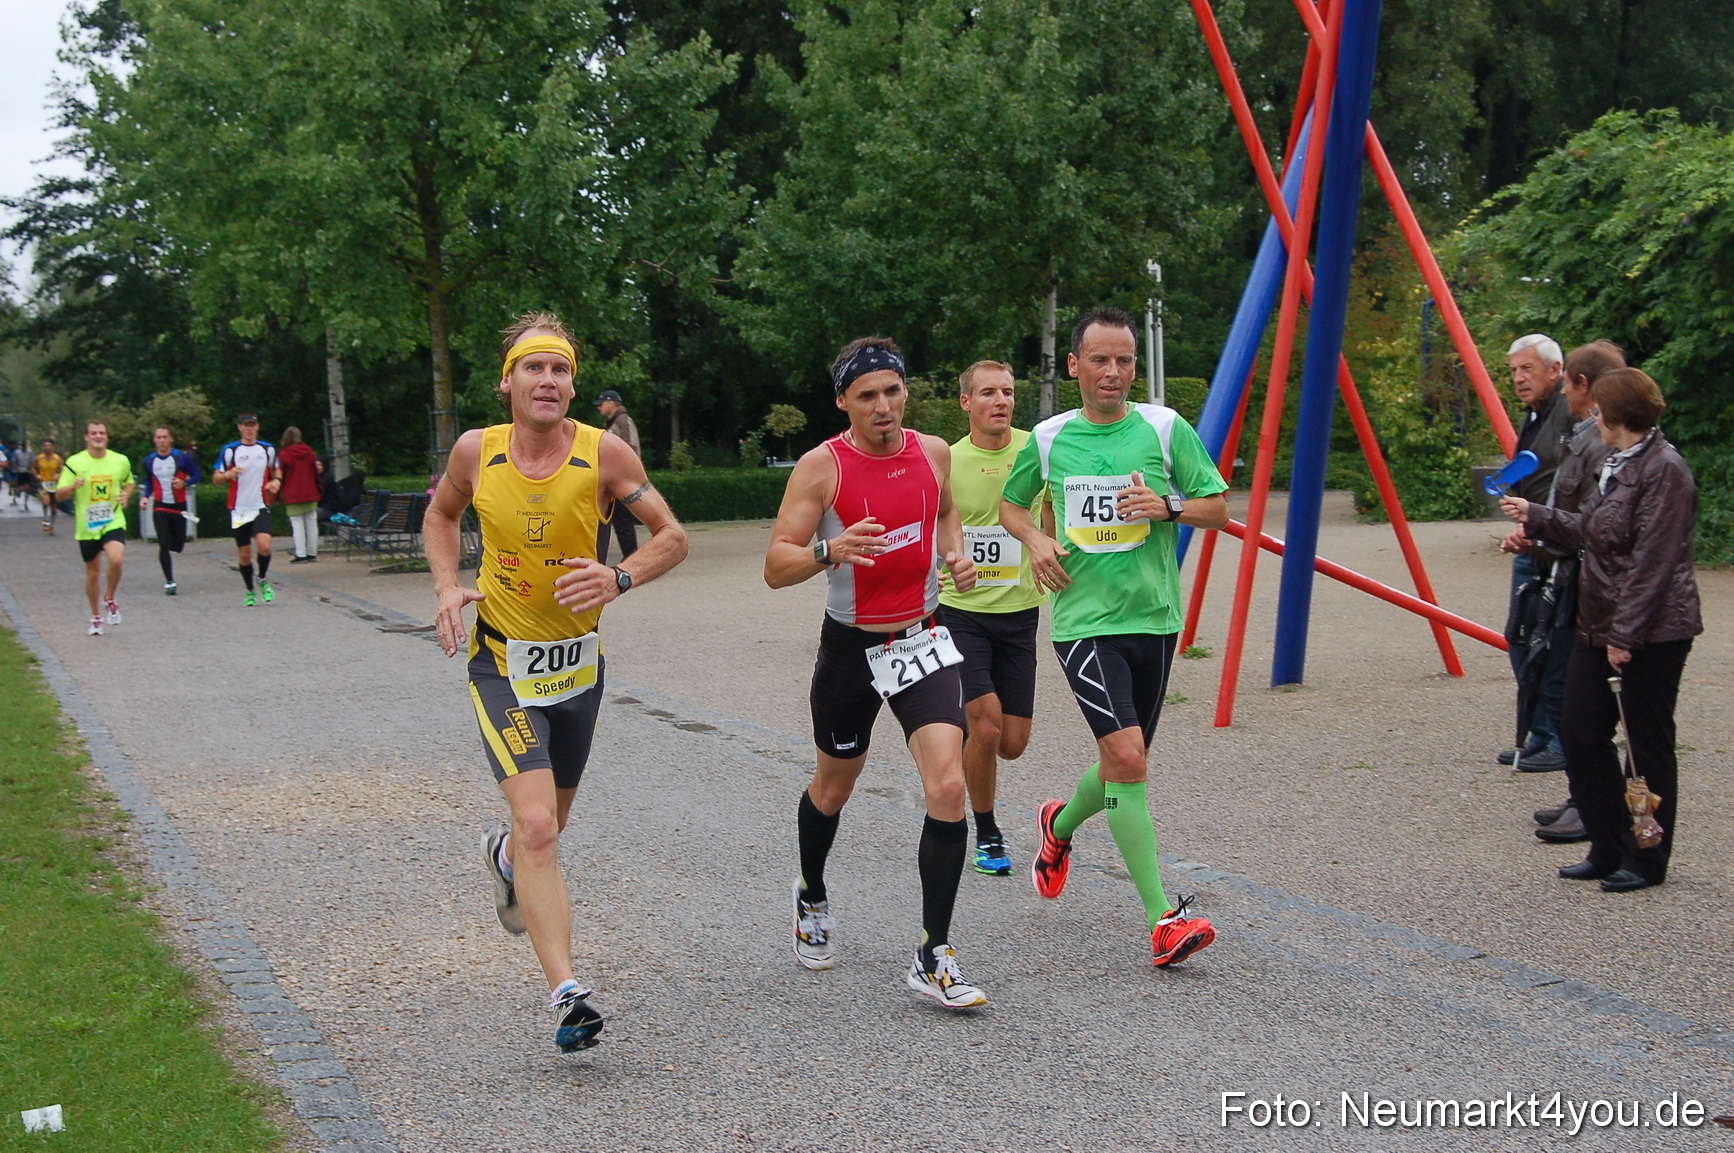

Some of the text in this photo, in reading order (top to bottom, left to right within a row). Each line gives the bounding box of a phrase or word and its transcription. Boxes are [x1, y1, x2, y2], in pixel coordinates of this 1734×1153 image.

[1065, 484, 1092, 492] PARTL
[888, 531, 909, 545] DEHN
[962, 531, 1009, 539] RTL Neumarkt
[1096, 530, 1117, 542] Udo
[497, 553, 520, 568] Seidl
[972, 541, 1001, 564] 59
[977, 570, 1001, 579] gmar
[527, 641, 583, 675] 200
[869, 636, 938, 663] PARTL Neumarkt
[890, 647, 944, 688] 211
[534, 675, 576, 697] Speedy
[511, 710, 537, 743] Run!
